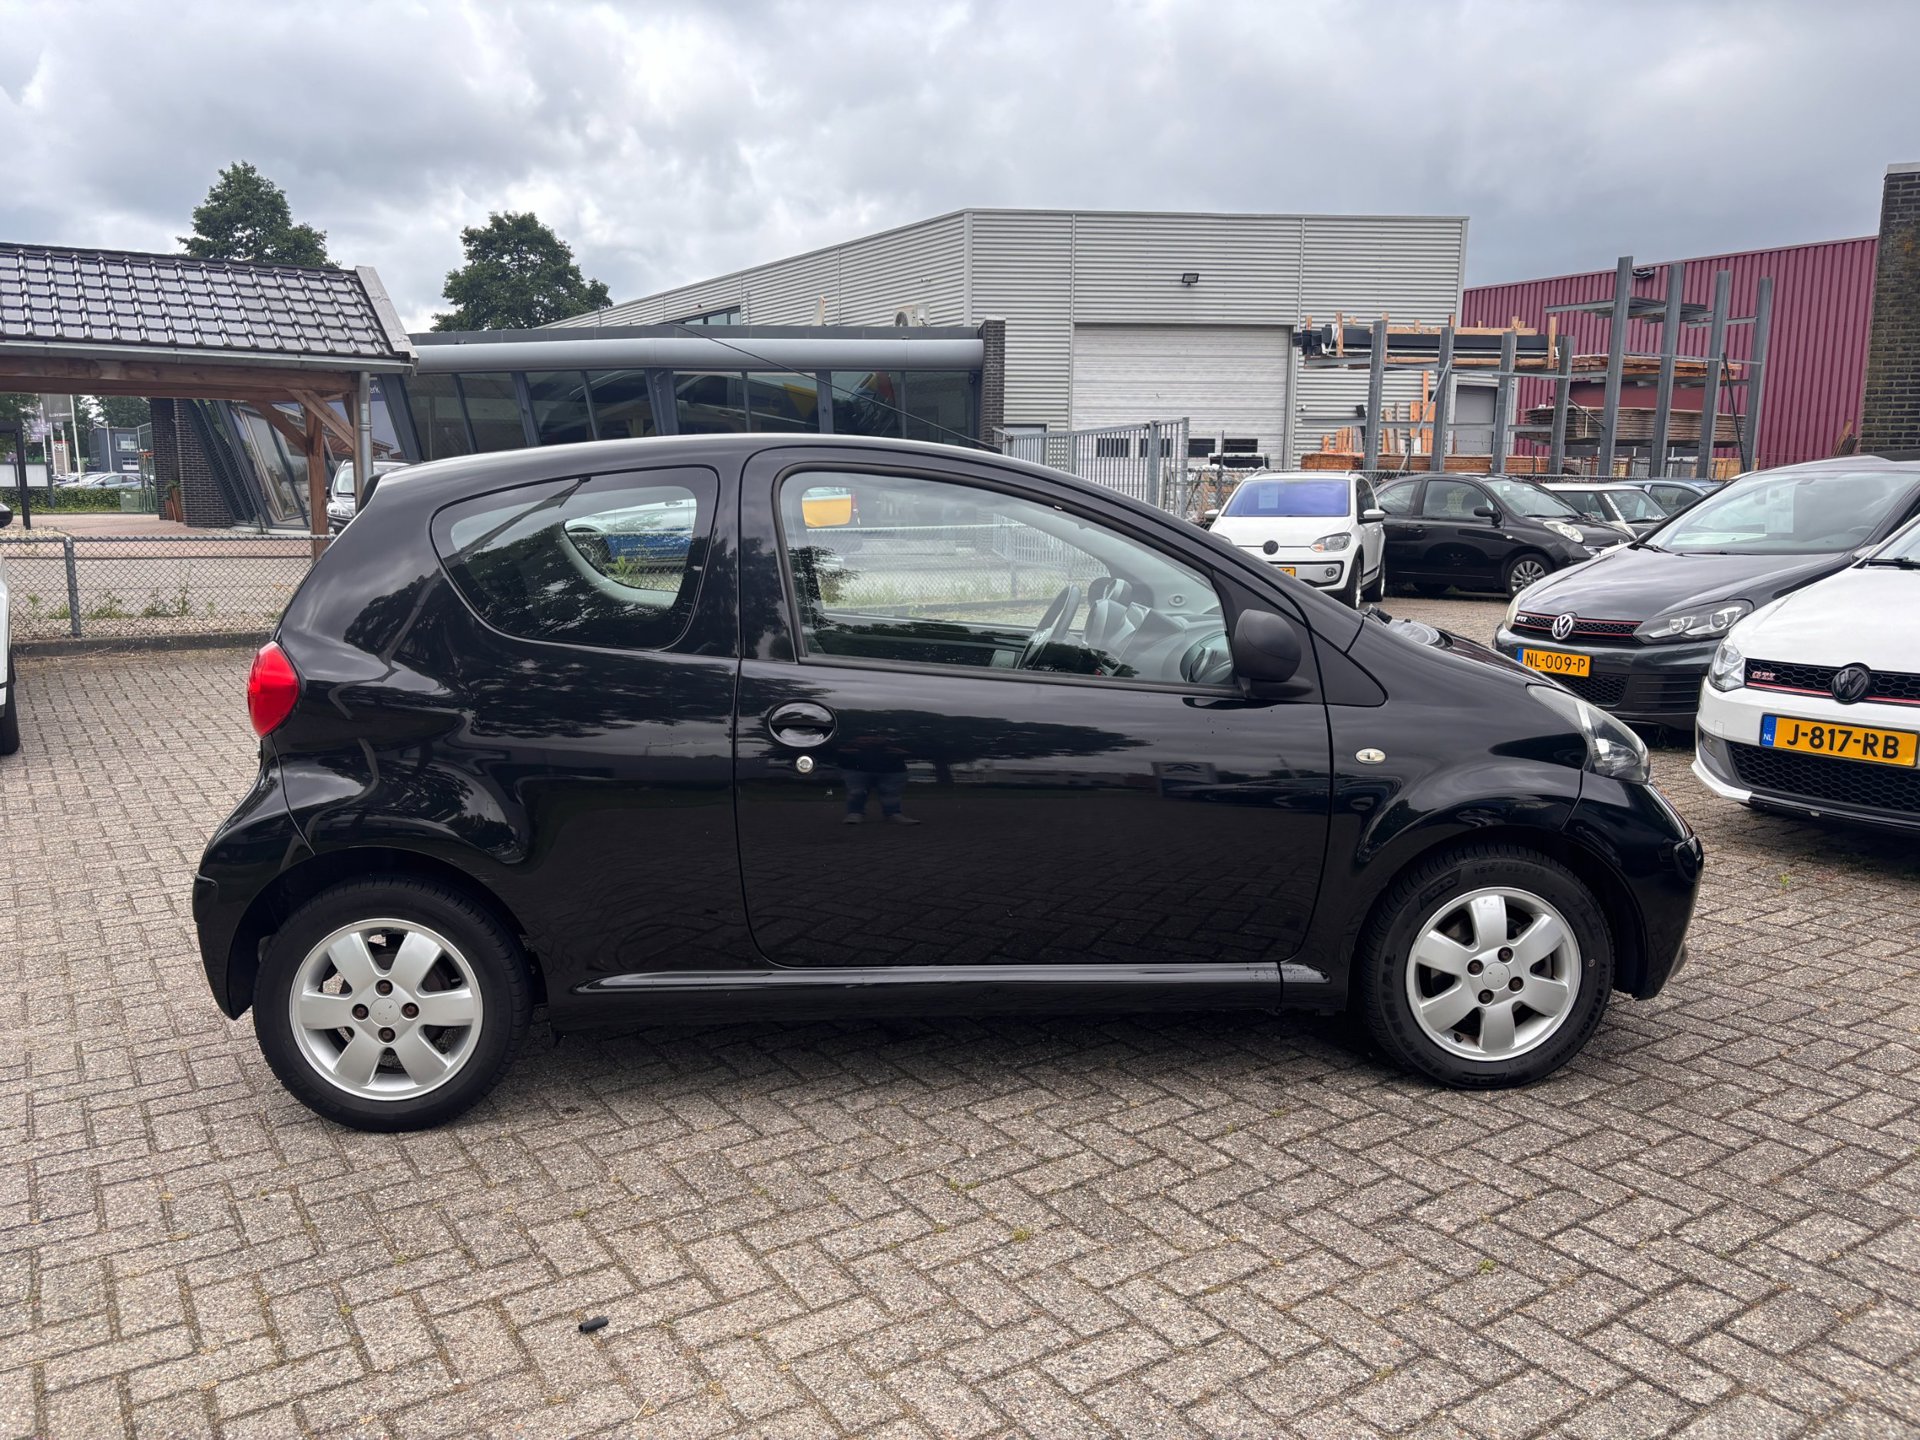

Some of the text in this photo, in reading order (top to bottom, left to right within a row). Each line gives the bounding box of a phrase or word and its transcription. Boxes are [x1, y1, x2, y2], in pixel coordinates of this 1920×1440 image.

[1516, 615, 1528, 623] GTI
[1525, 652, 1586, 673] NL-009-P
[1751, 671, 1776, 681] GTI
[1763, 732, 1773, 742] NL
[1786, 723, 1900, 759] J-817-RB
[1578, 987, 1605, 1038] SEASON
